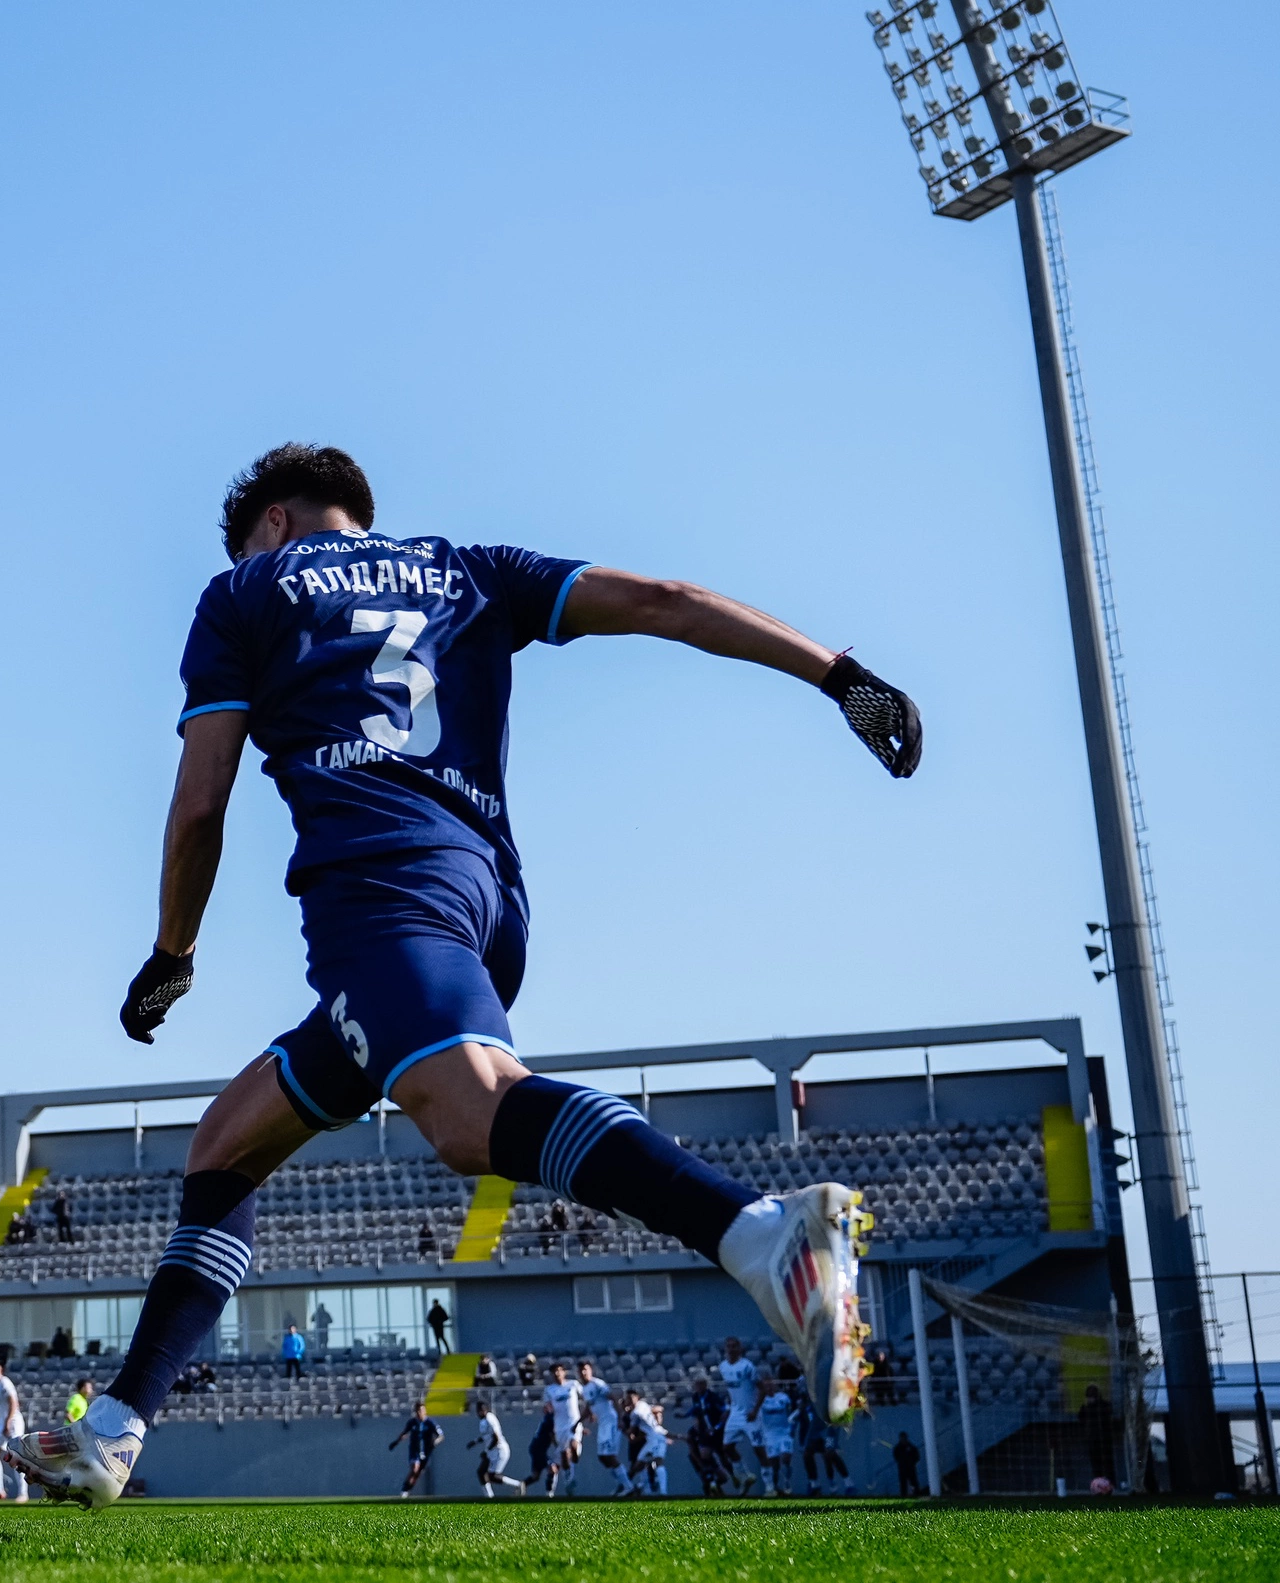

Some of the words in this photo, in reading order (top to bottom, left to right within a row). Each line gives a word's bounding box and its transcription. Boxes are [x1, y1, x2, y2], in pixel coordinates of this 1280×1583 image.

[277, 559, 464, 605] ГАЛДАМЕС
[350, 608, 442, 757] 3
[330, 990, 369, 1069] 3
